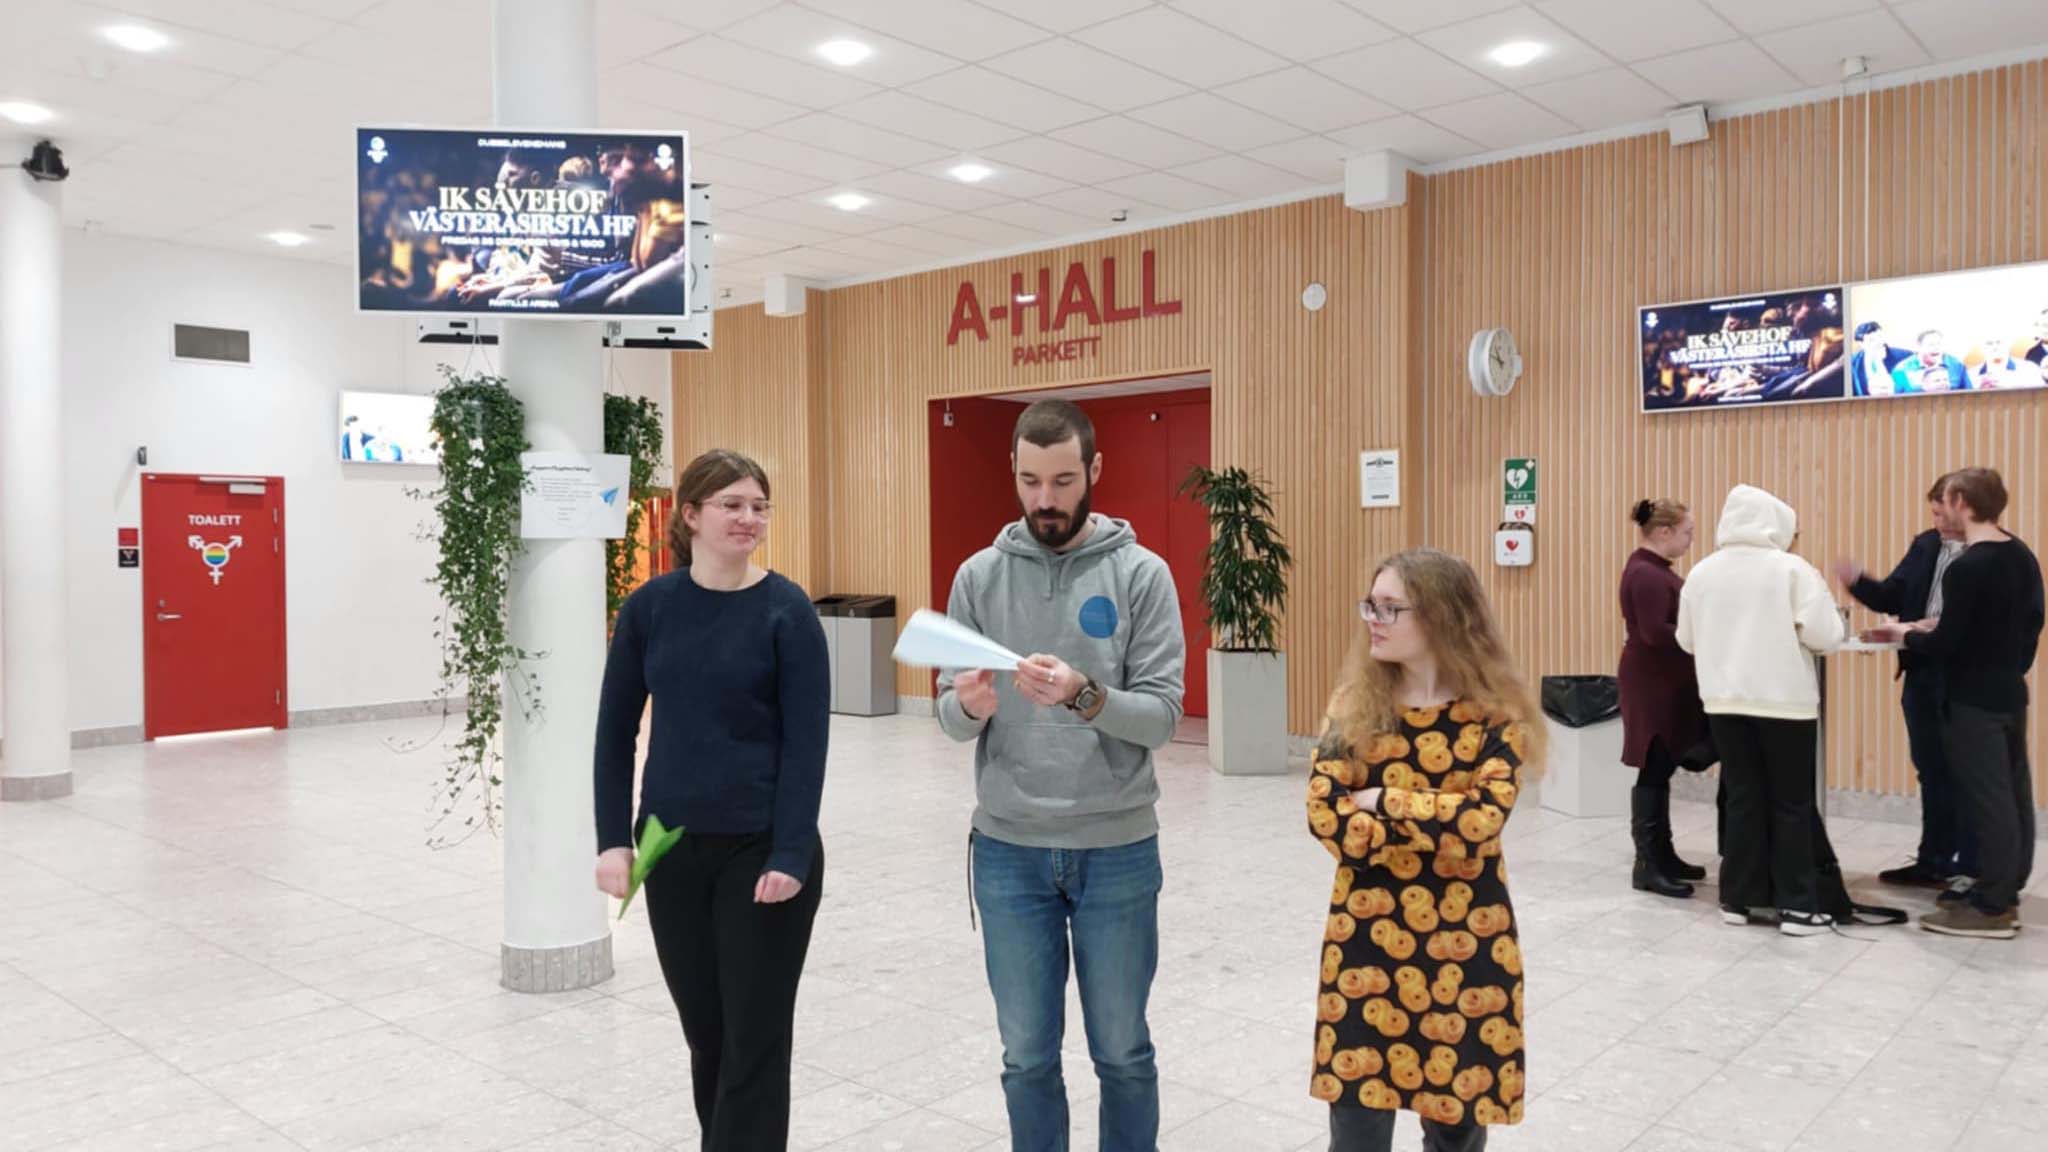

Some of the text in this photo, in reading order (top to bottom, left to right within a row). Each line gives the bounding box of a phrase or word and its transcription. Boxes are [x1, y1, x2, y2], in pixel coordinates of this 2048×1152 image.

[439, 182, 607, 213] IK SÄVEHOF
[602, 215, 637, 237] HF
[947, 250, 1182, 345] A-HALL
[1013, 336, 1101, 367] PARKETT
[1687, 335, 1708, 350] IK
[188, 514, 241, 525] TOALETT
